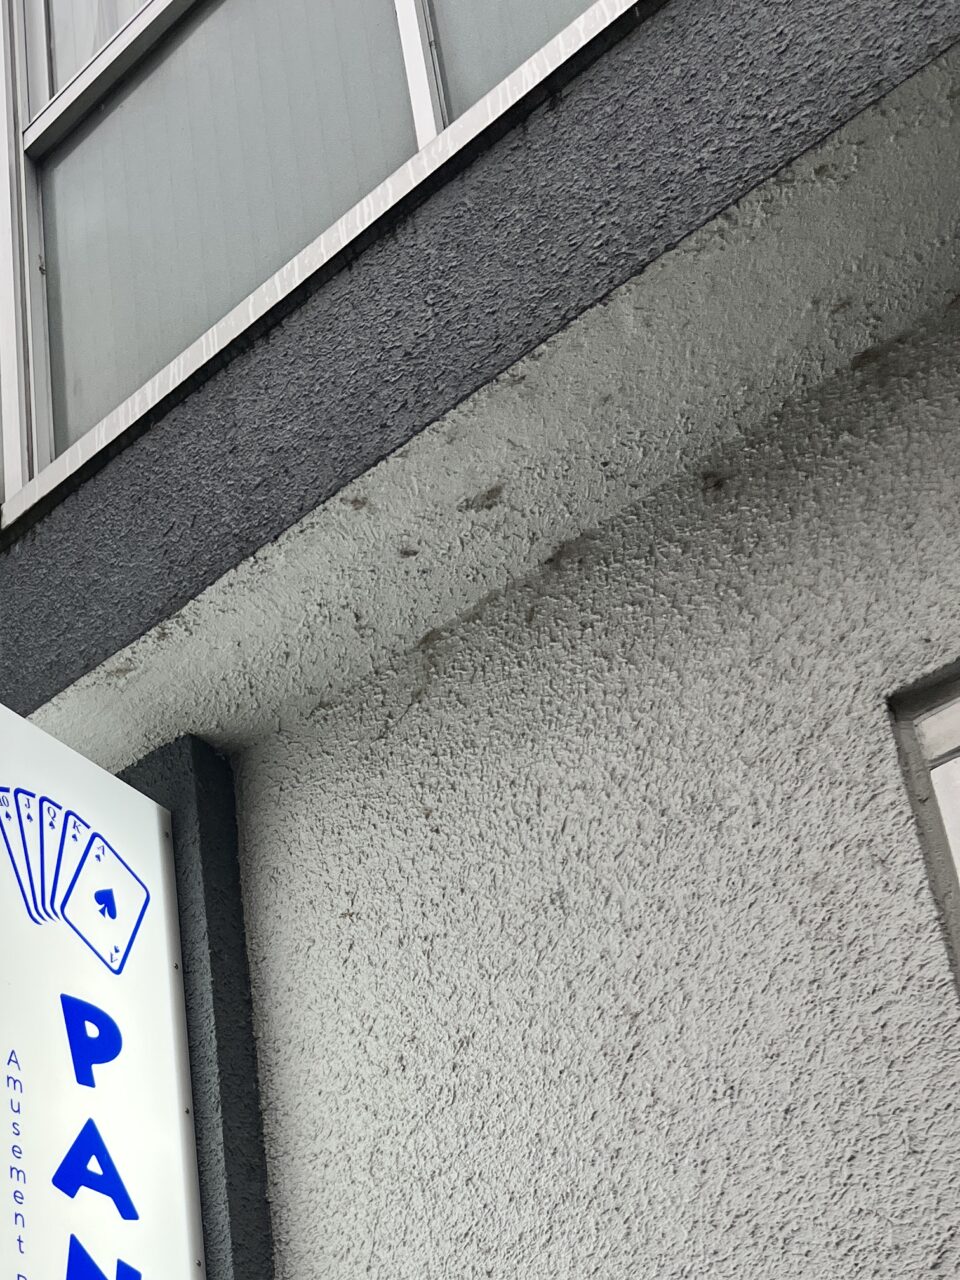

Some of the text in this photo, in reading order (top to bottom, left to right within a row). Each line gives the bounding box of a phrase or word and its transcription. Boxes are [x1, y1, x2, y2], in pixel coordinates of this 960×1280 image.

[24, 798, 31, 809] J
[47, 806, 57, 821] Q
[72, 820, 83, 834] K
[7, 1049, 27, 1255] Amusement
